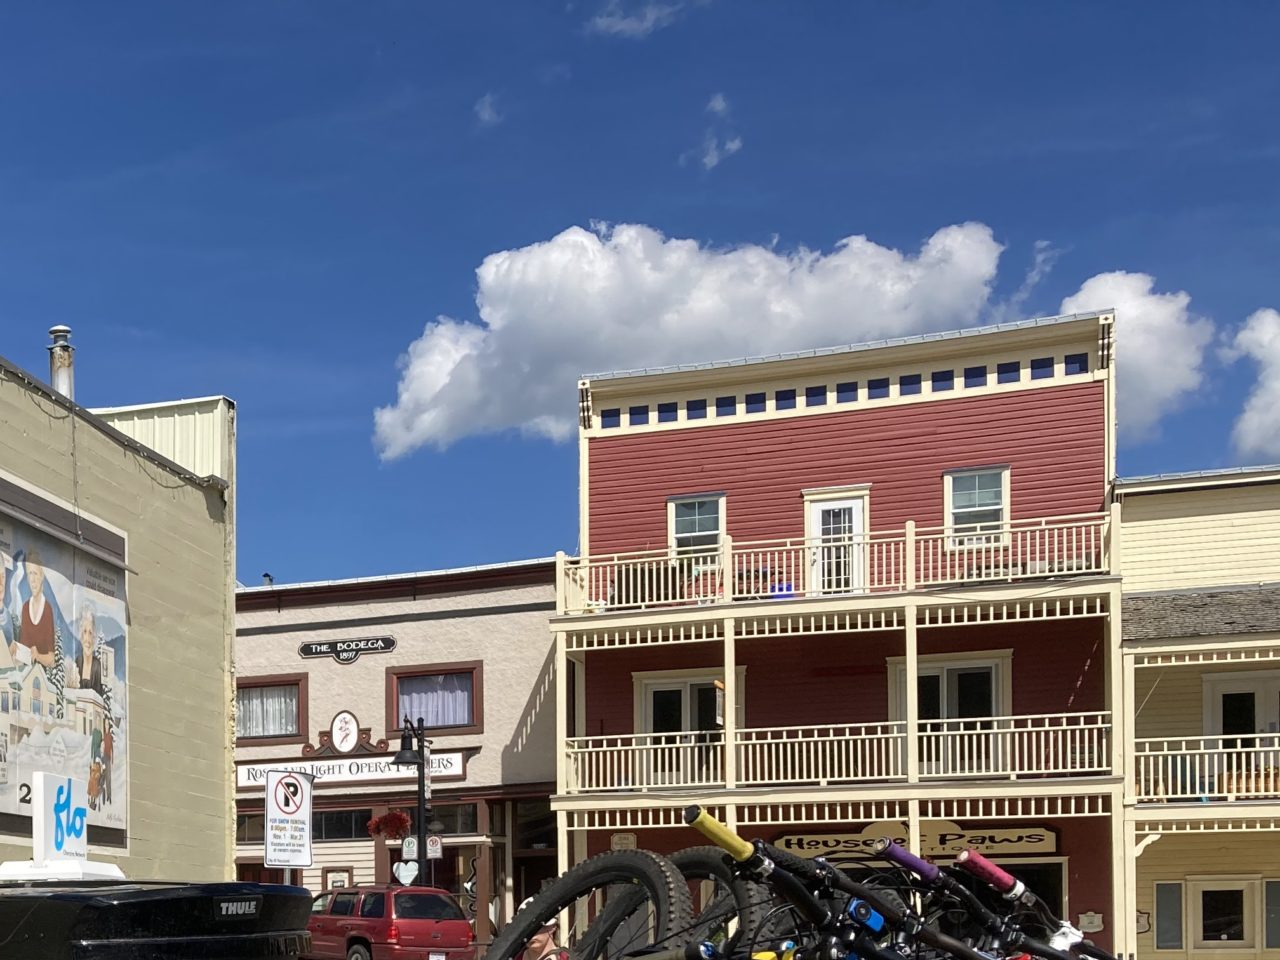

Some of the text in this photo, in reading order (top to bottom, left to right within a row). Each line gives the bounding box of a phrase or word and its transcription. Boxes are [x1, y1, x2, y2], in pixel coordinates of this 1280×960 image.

[310, 639, 385, 653] THE BODEGA
[340, 651, 356, 660] 1897
[311, 764, 344, 779] LIGHT
[349, 761, 392, 776] OPERA
[54, 778, 87, 851] flo
[938, 833, 1045, 846] Paws
[220, 901, 257, 916] THULE
